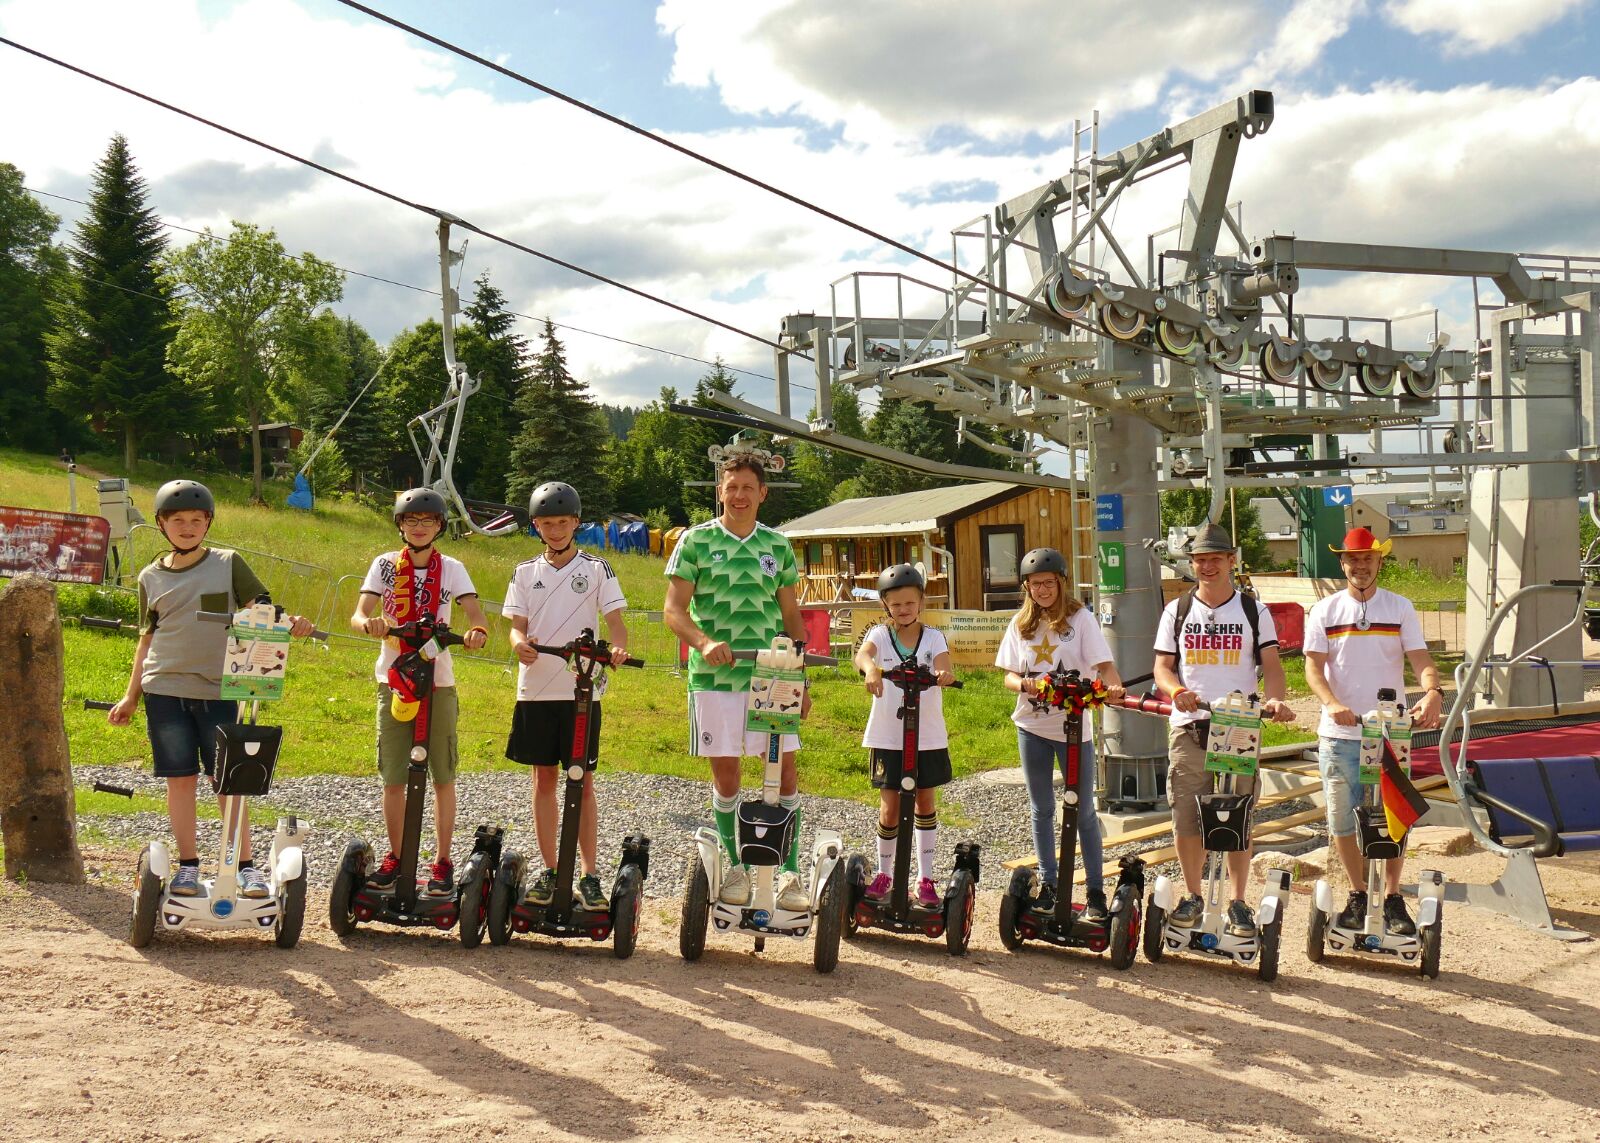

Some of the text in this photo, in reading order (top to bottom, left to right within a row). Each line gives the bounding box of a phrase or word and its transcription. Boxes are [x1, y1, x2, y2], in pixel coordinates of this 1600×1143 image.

[950, 615, 974, 623] Immer
[1184, 623, 1243, 634] SO SEHEN
[1184, 634, 1243, 650] SIEGER
[1185, 649, 1240, 665] AUS !!!
